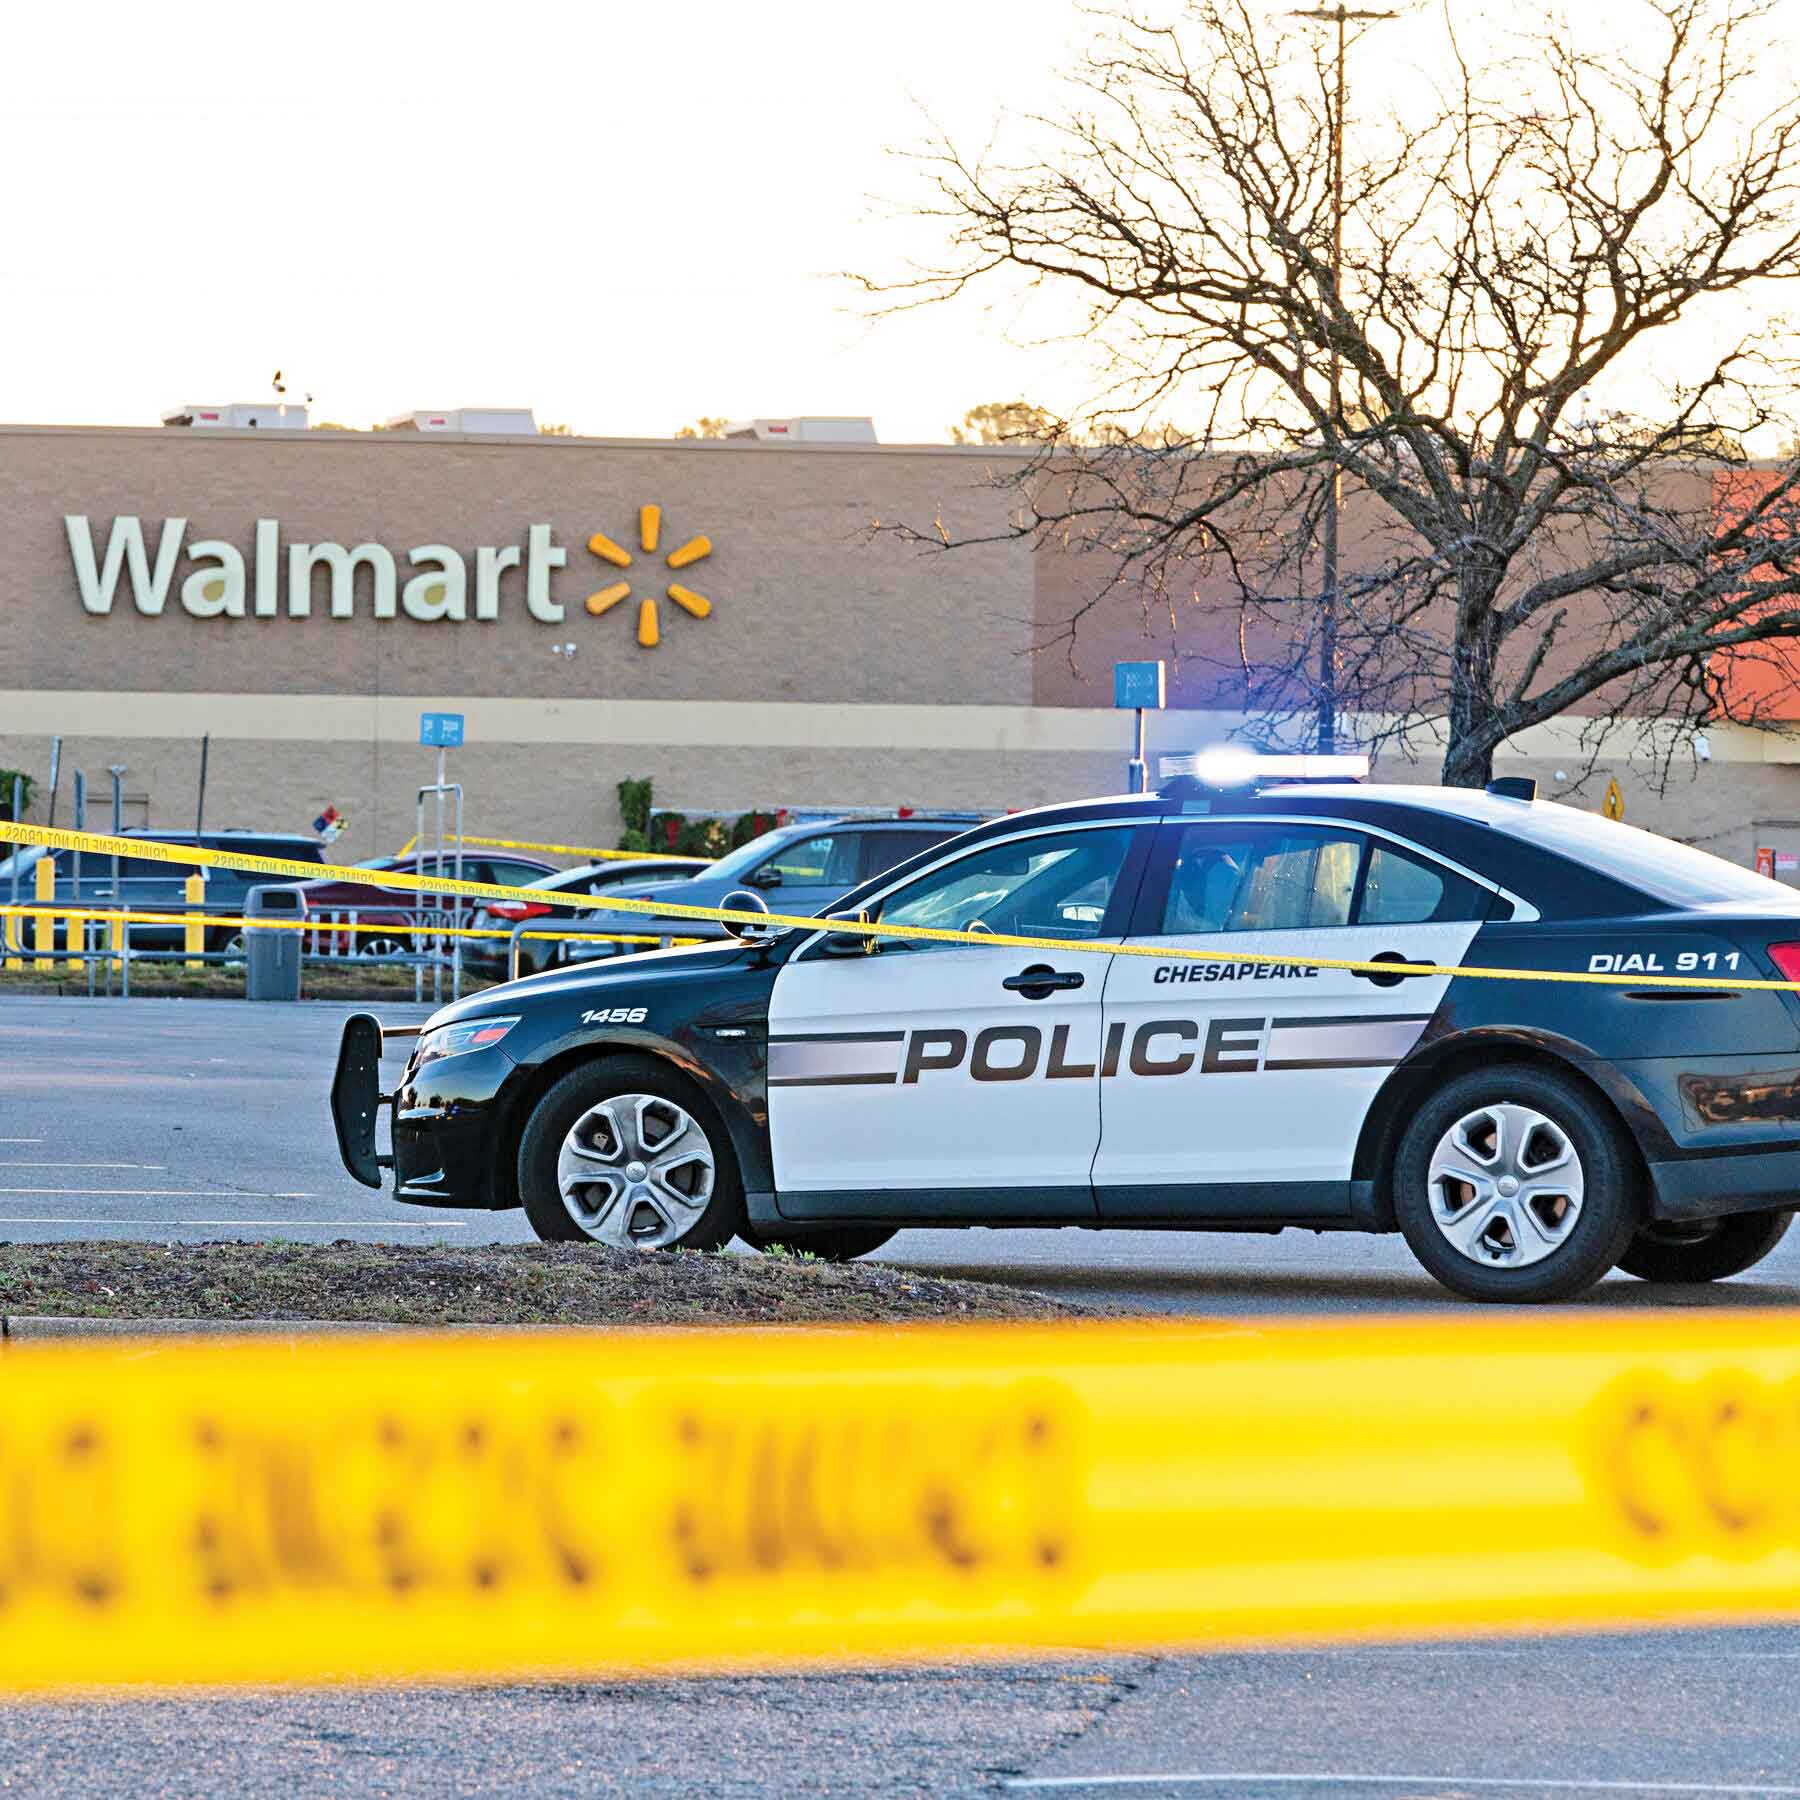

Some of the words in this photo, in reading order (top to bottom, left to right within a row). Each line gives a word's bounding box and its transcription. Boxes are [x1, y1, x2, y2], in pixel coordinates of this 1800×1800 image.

[64, 514, 567, 622] Walmart
[1153, 963, 1319, 983] CHESAPEAKE
[1588, 954, 1664, 973] DIAL
[1676, 952, 1741, 971] 911
[581, 1007, 648, 1024] 1456
[903, 1018, 1266, 1084] POLICE
